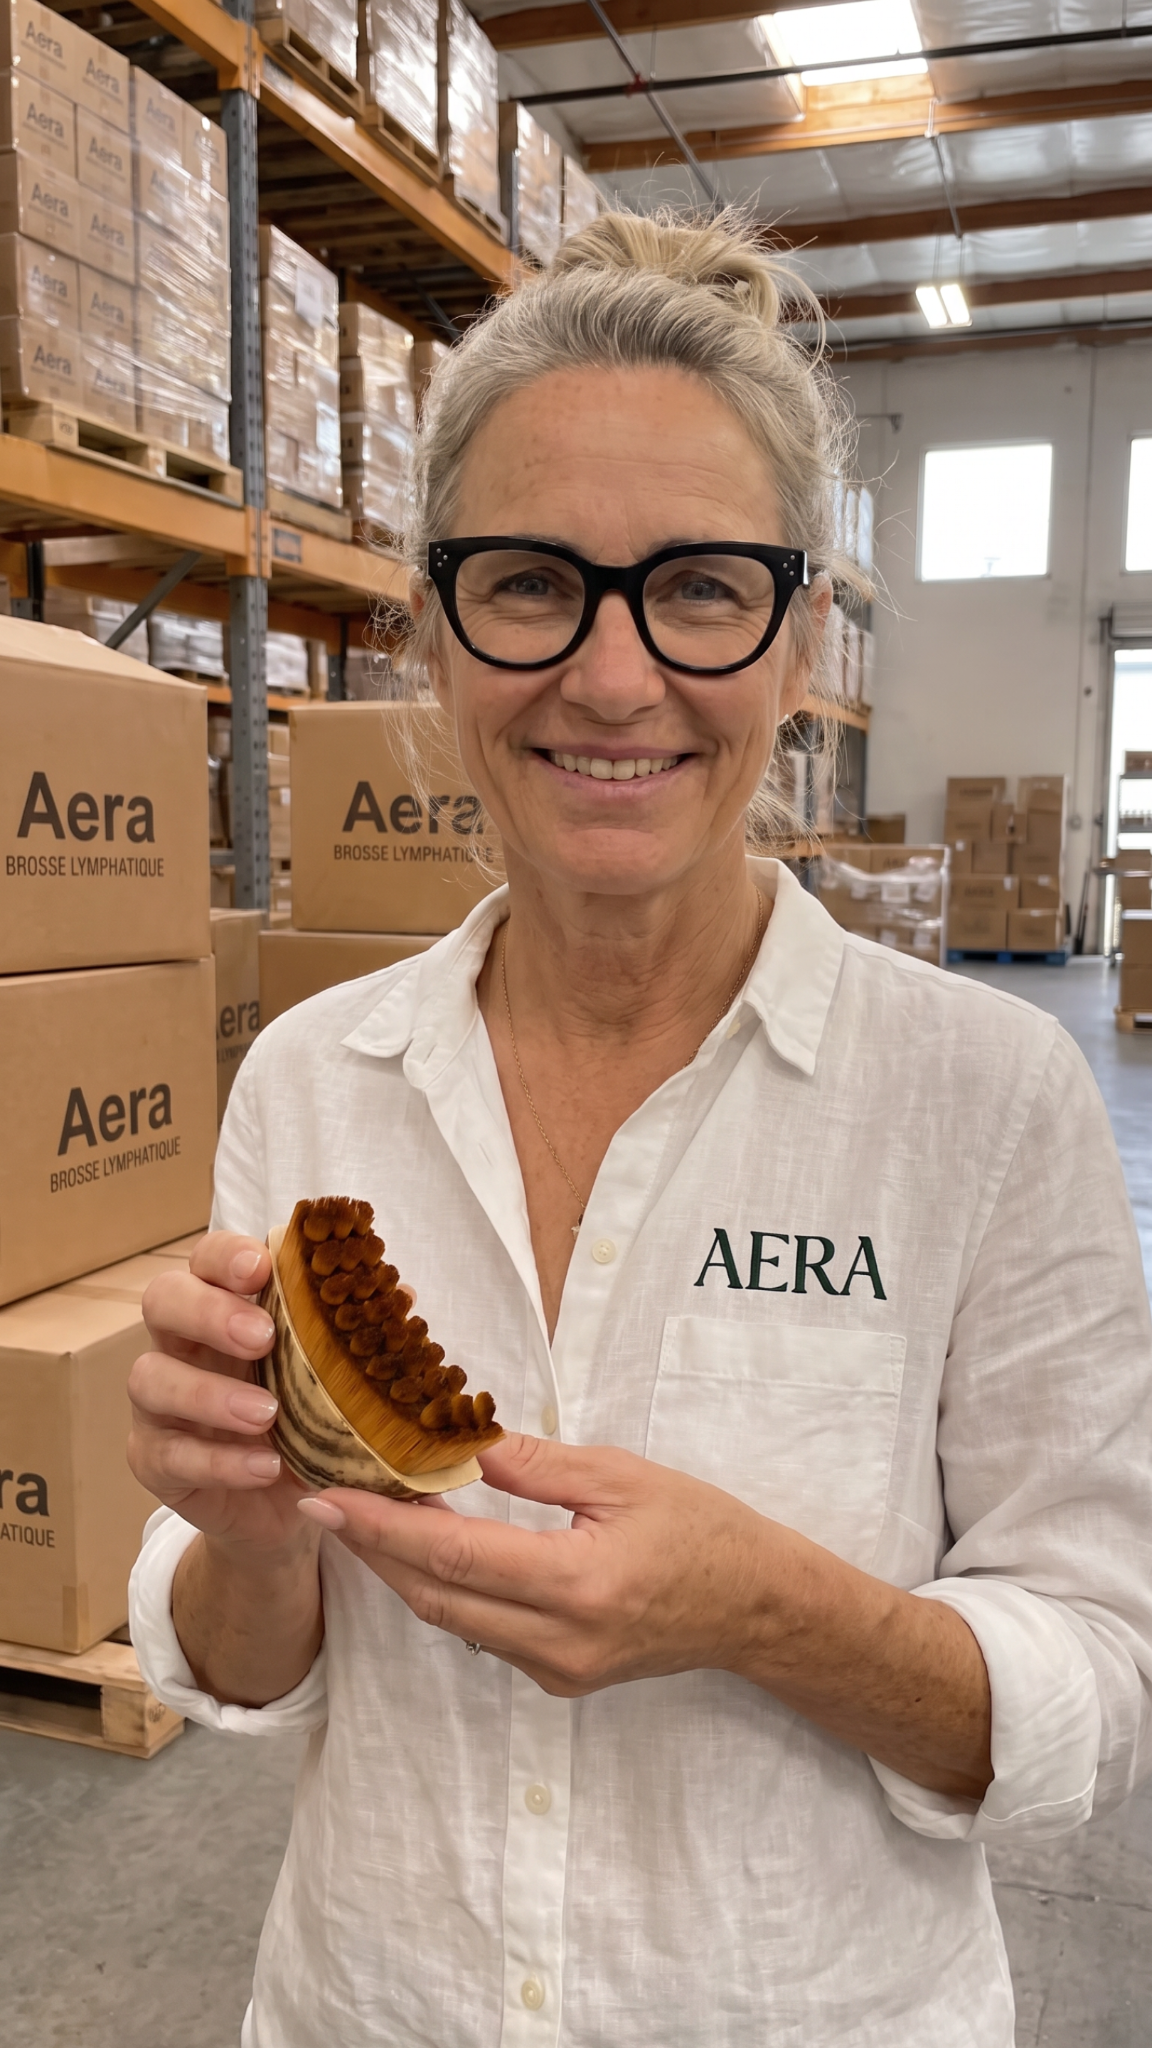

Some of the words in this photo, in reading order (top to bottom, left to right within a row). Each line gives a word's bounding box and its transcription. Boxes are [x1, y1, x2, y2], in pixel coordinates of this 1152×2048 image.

[26, 20, 63, 59] Aera
[27, 102, 64, 138] Aera
[88, 136, 123, 171] Aera
[31, 182, 69, 217] Aera
[91, 291, 125, 324] Aera
[33, 344, 72, 376] Aera
[17, 771, 155, 843] Aera
[342, 780, 484, 835] Aera
[6, 855, 66, 876] BROSSE
[71, 856, 165, 877] LYMPHATIQUE
[333, 844, 389, 861] BROSSE
[216, 1000, 260, 1040] era
[57, 1083, 172, 1157] Aera
[50, 1160, 100, 1193] BROSSE
[103, 1136, 181, 1177] LYMPHATIQUE
[693, 1228, 888, 1301] AERA
